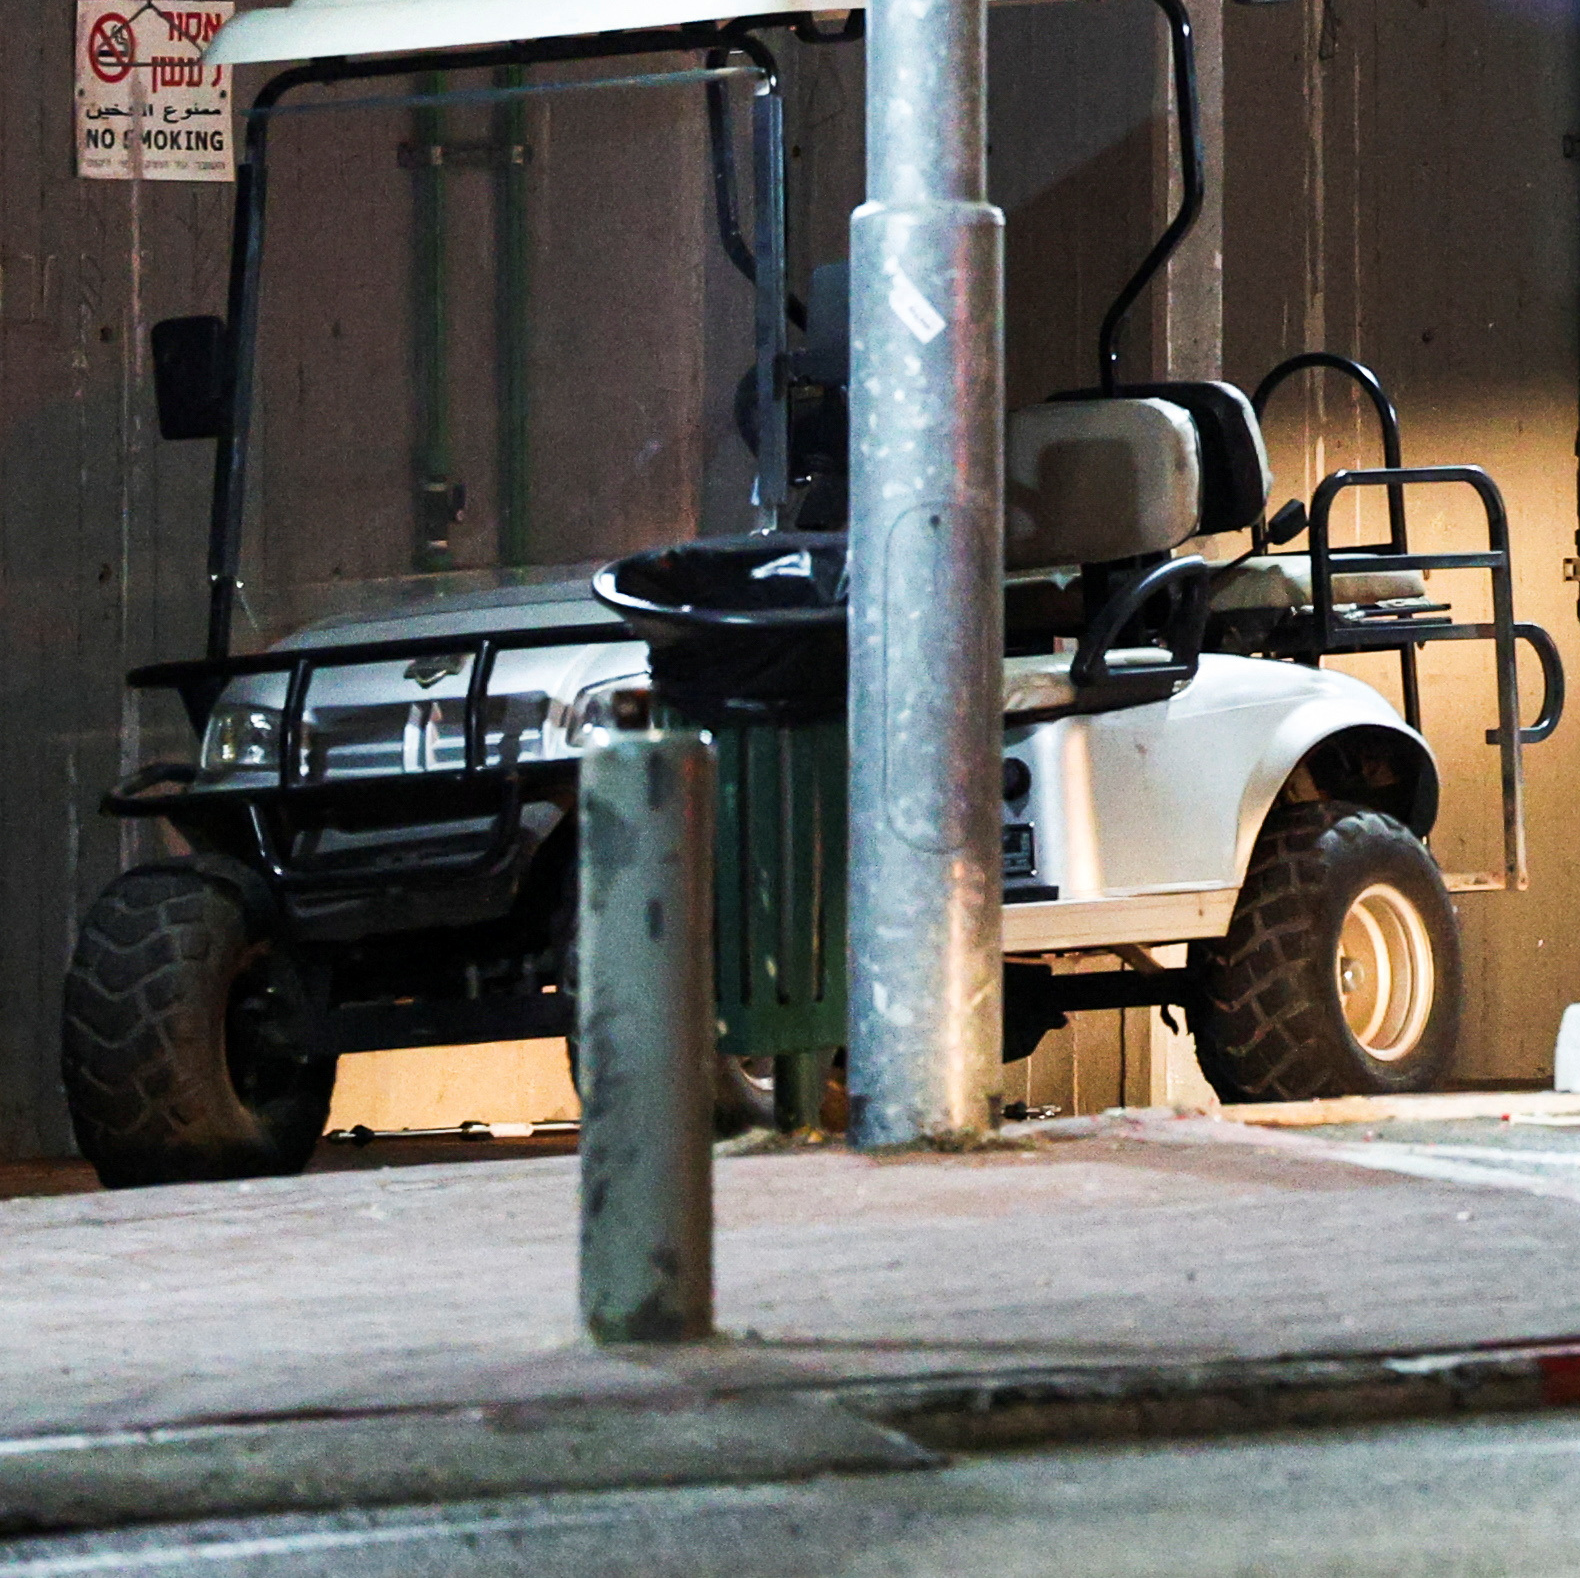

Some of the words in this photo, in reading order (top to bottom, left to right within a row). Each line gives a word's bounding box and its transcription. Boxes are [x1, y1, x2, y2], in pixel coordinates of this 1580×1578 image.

[161, 10, 223, 42] אסור
[163, 102, 222, 124] ممنوع
[85, 128, 116, 150] NO
